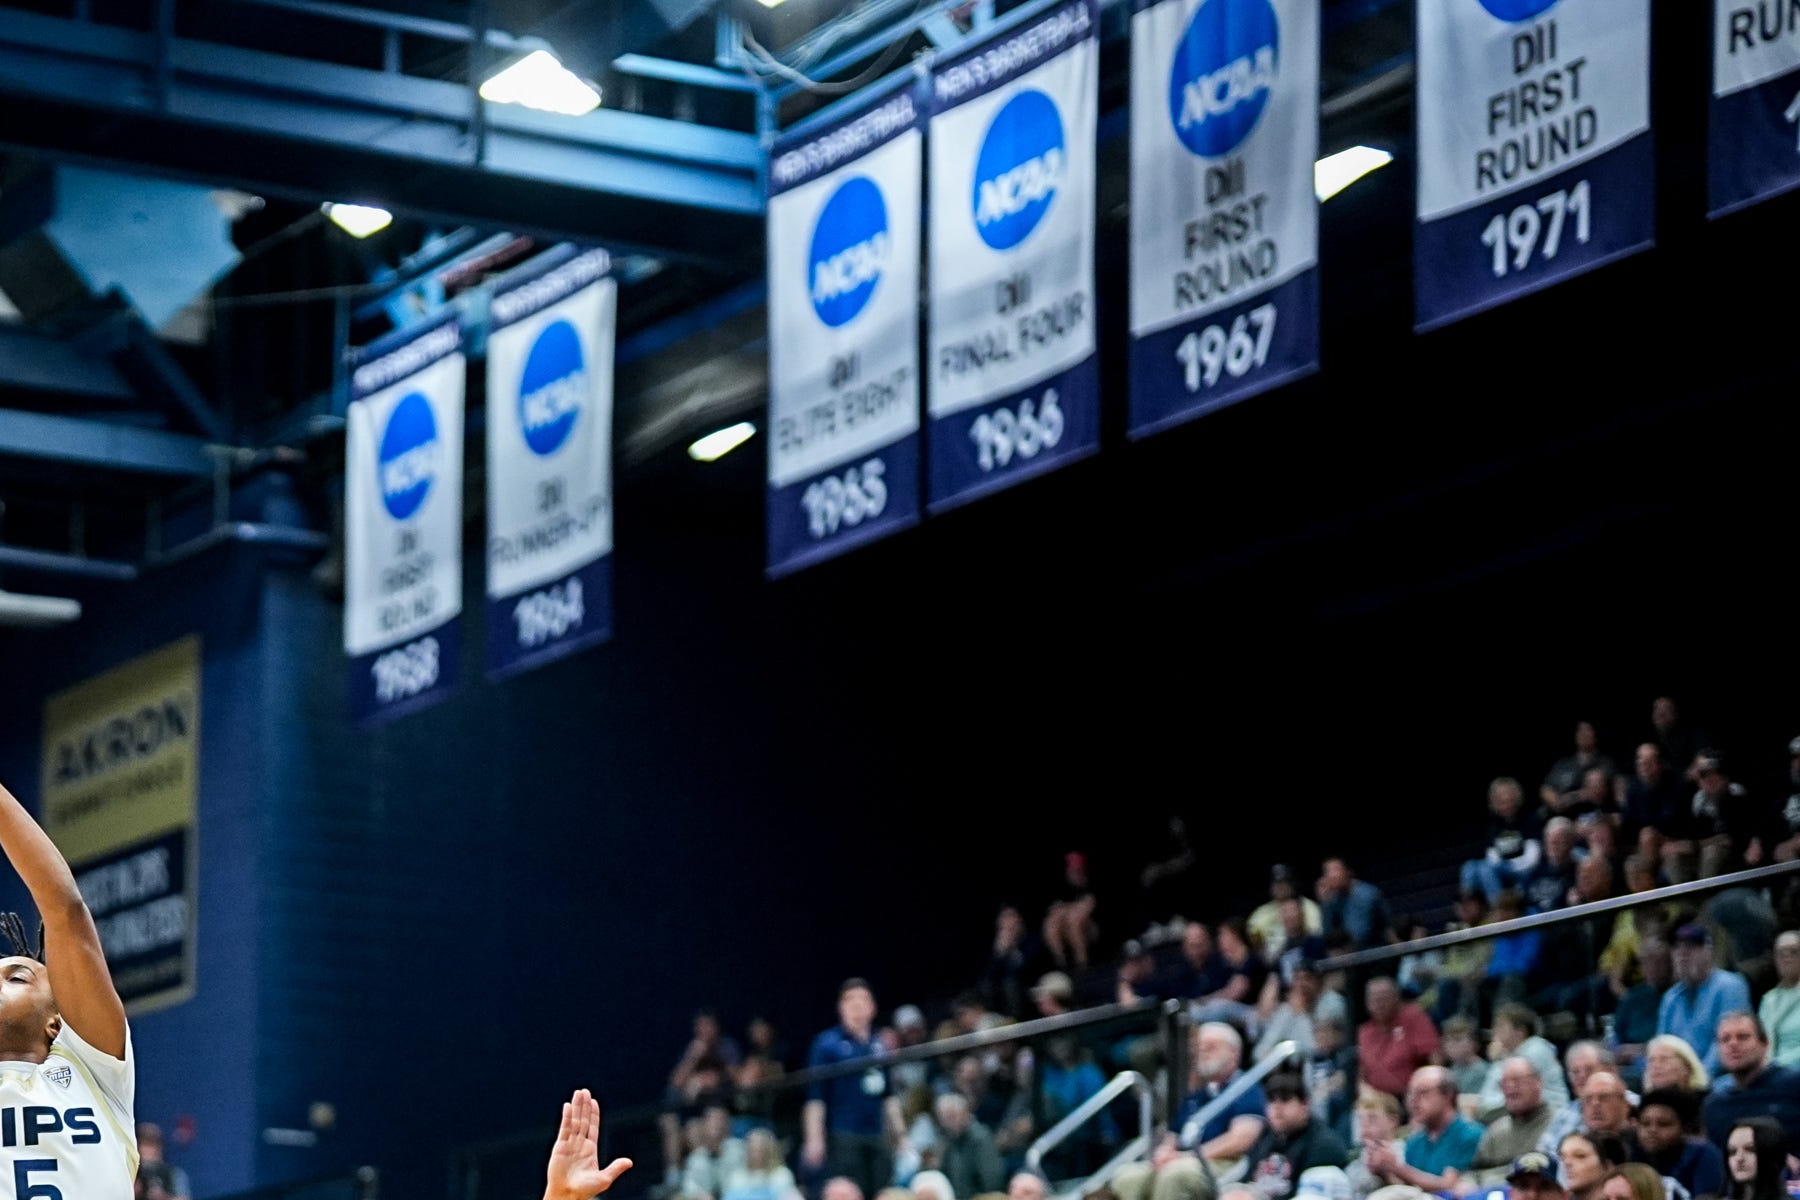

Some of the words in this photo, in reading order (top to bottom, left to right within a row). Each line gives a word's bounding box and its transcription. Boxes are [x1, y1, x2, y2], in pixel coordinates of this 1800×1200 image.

[1179, 44, 1279, 130] NCAA
[1487, 57, 1587, 136] FIRST
[1475, 105, 1597, 191] ROUND
[1183, 191, 1270, 261] FIRST
[1480, 179, 1591, 278] 1971
[1173, 238, 1279, 310] ROUND
[1175, 302, 1278, 393] 1967
[968, 387, 1065, 473] 1966
[801, 458, 889, 540] 1965
